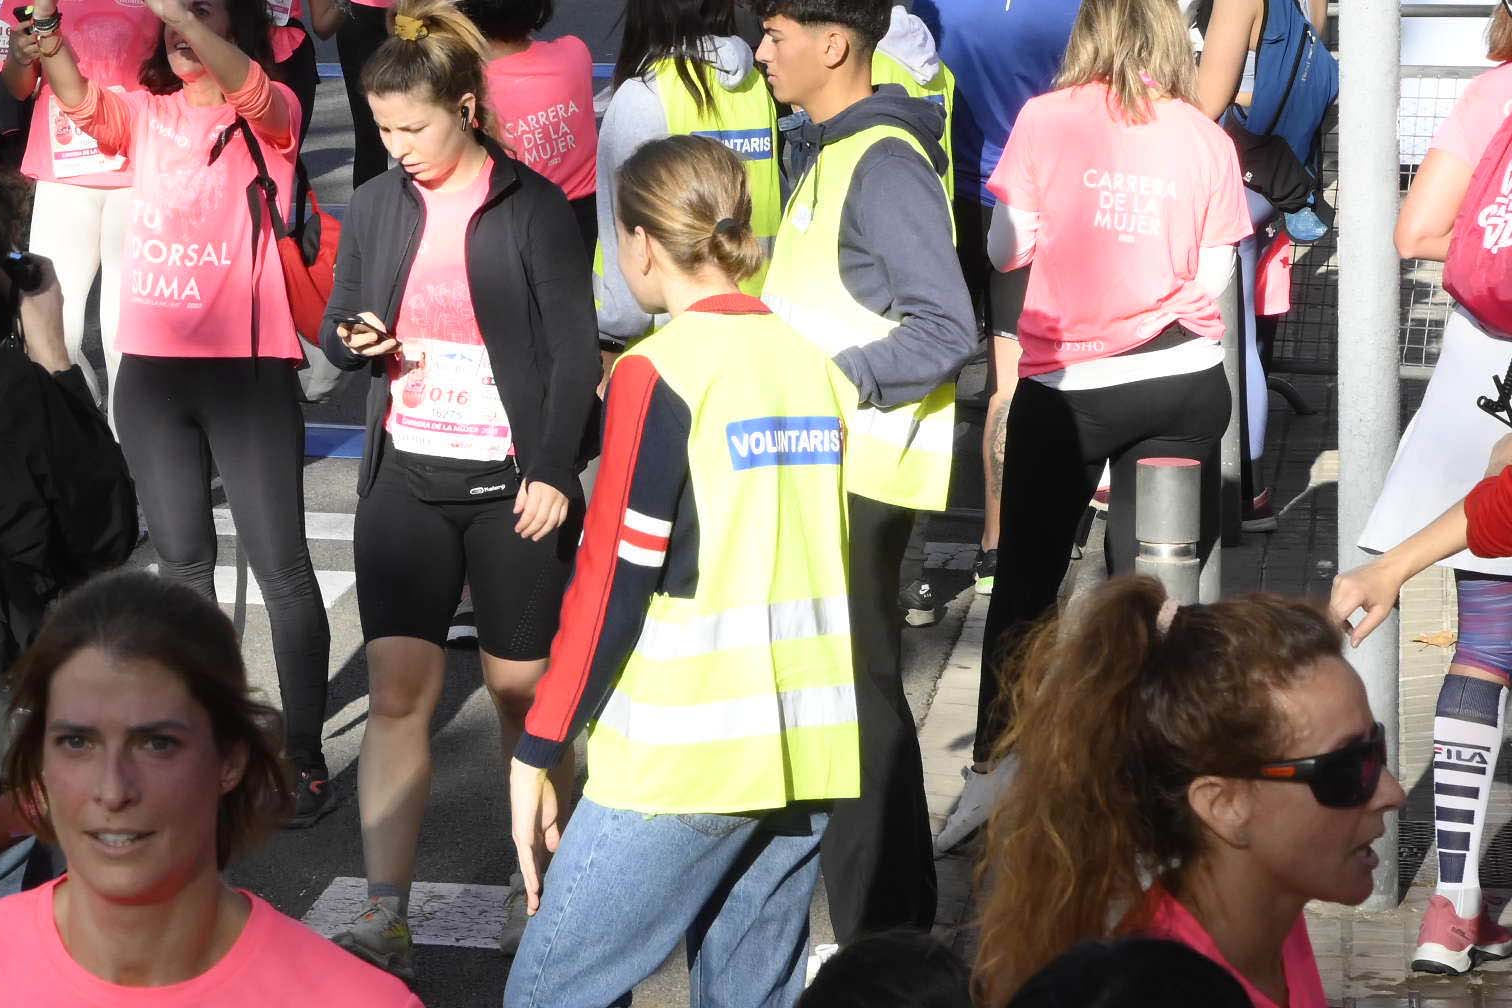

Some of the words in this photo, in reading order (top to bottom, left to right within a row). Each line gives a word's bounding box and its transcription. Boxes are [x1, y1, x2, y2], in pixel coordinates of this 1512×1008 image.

[504, 100, 580, 140] CARRERA
[522, 131, 545, 149] DE
[551, 121, 570, 139] LA
[522, 134, 577, 166] MUJER
[1083, 169, 1177, 200] CARRERA
[131, 198, 161, 229] TU
[1099, 192, 1127, 210] DE
[1137, 196, 1159, 214] LA
[1094, 212, 1162, 235] MUJER
[131, 236, 231, 267] DORSAL
[131, 270, 201, 301] SUMA
[430, 387, 469, 405] 016
[731, 429, 840, 458] VOLUNTARIS
